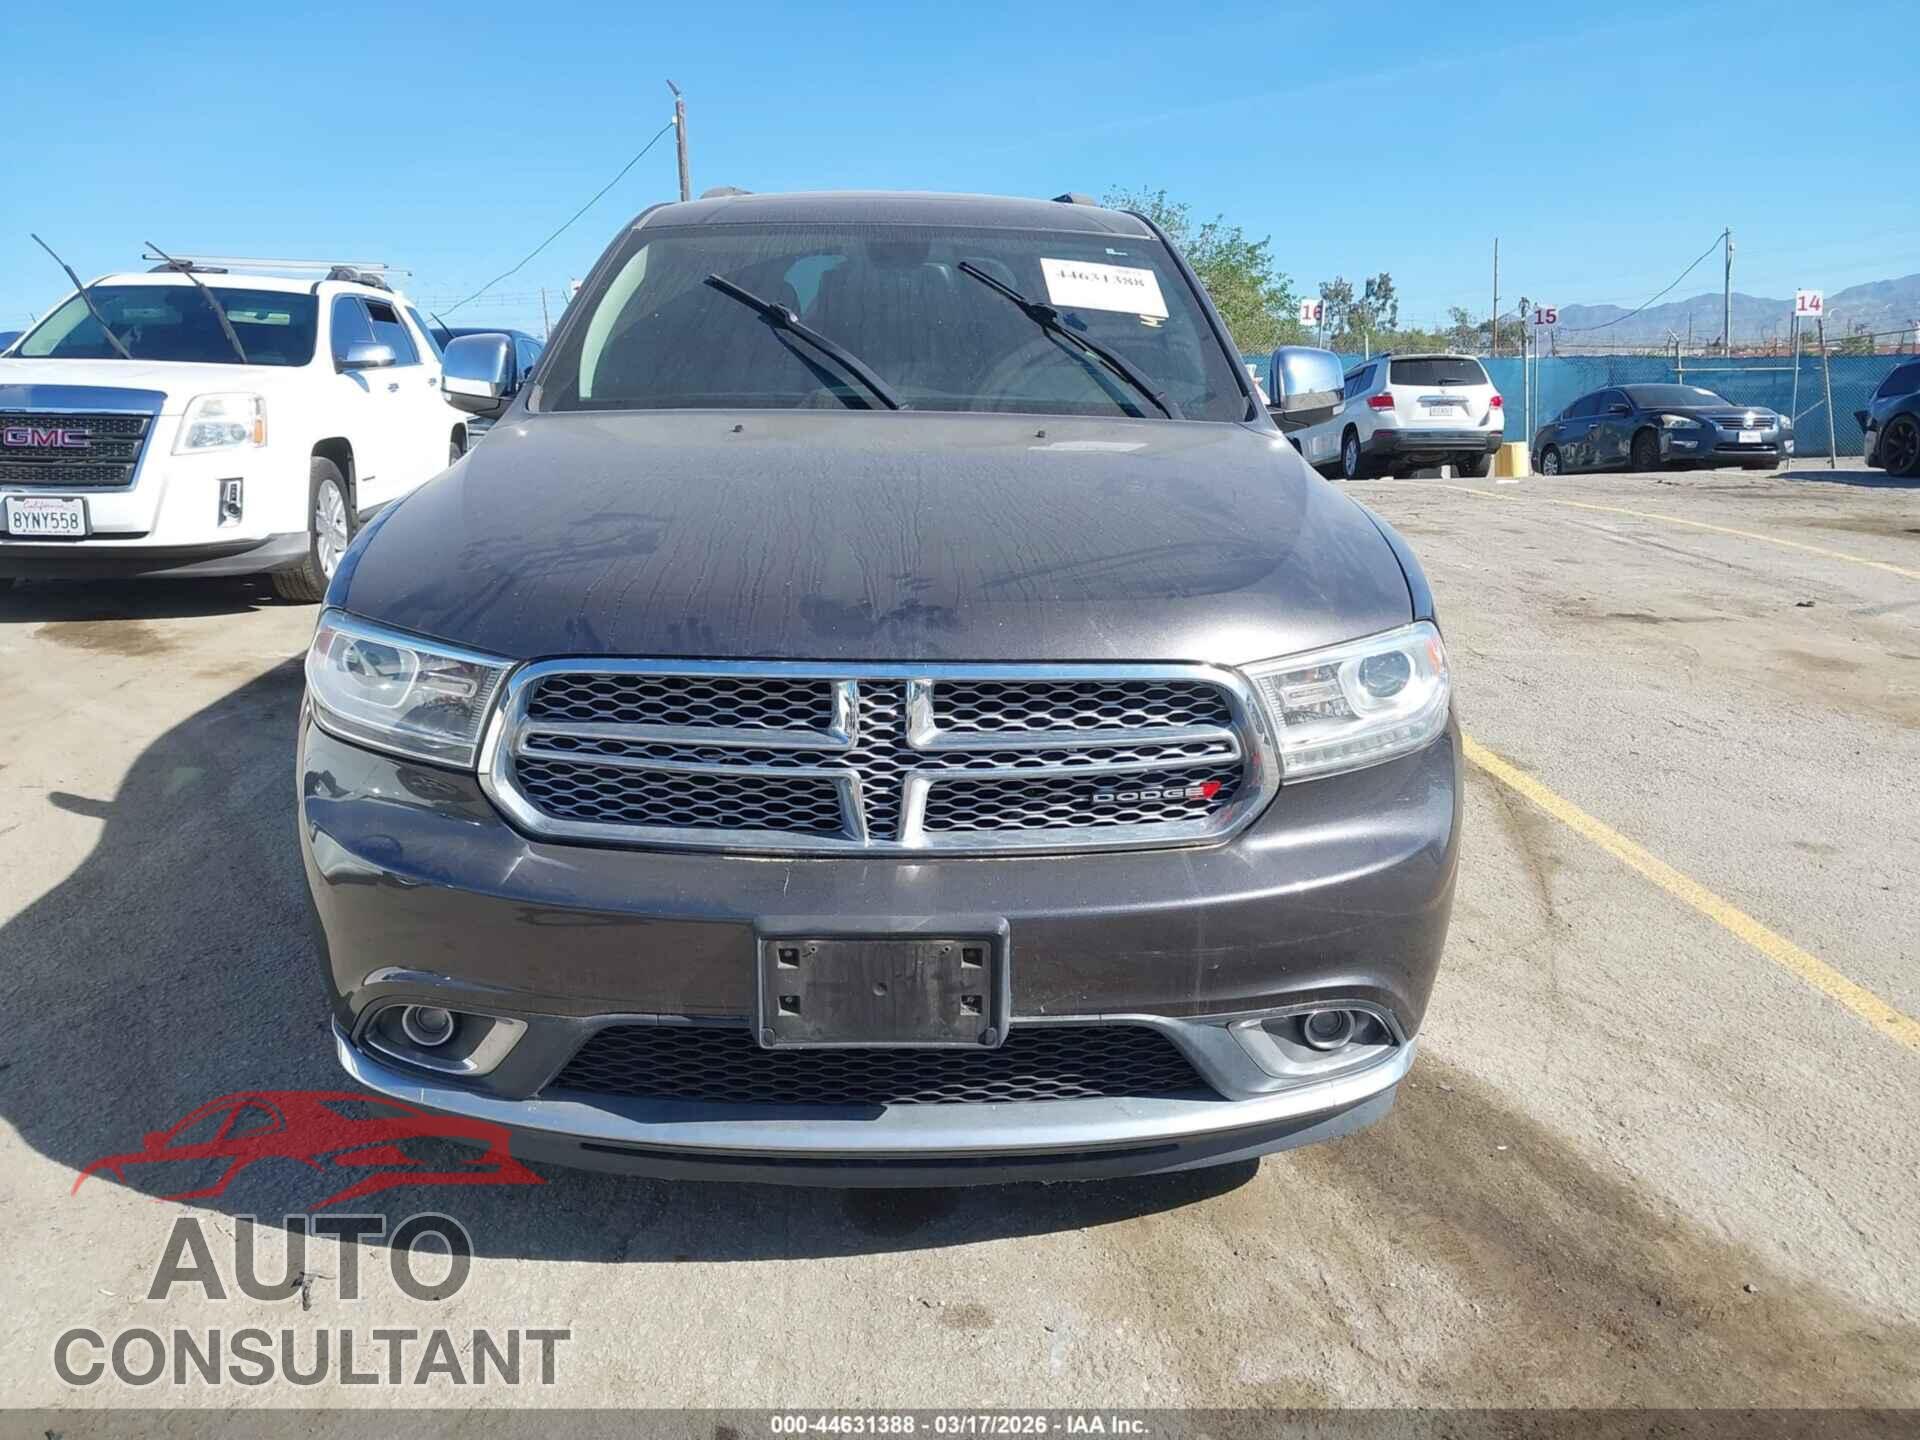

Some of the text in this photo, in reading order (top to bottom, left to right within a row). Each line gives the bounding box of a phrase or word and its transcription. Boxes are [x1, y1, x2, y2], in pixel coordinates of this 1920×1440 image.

[1797, 295, 1821, 311] 14
[1302, 304, 1323, 321] 16
[1534, 308, 1557, 325] 15
[4, 426, 91, 448] GMC
[13, 511, 79, 529] 8YNY558
[1092, 786, 1204, 803] DODGE
